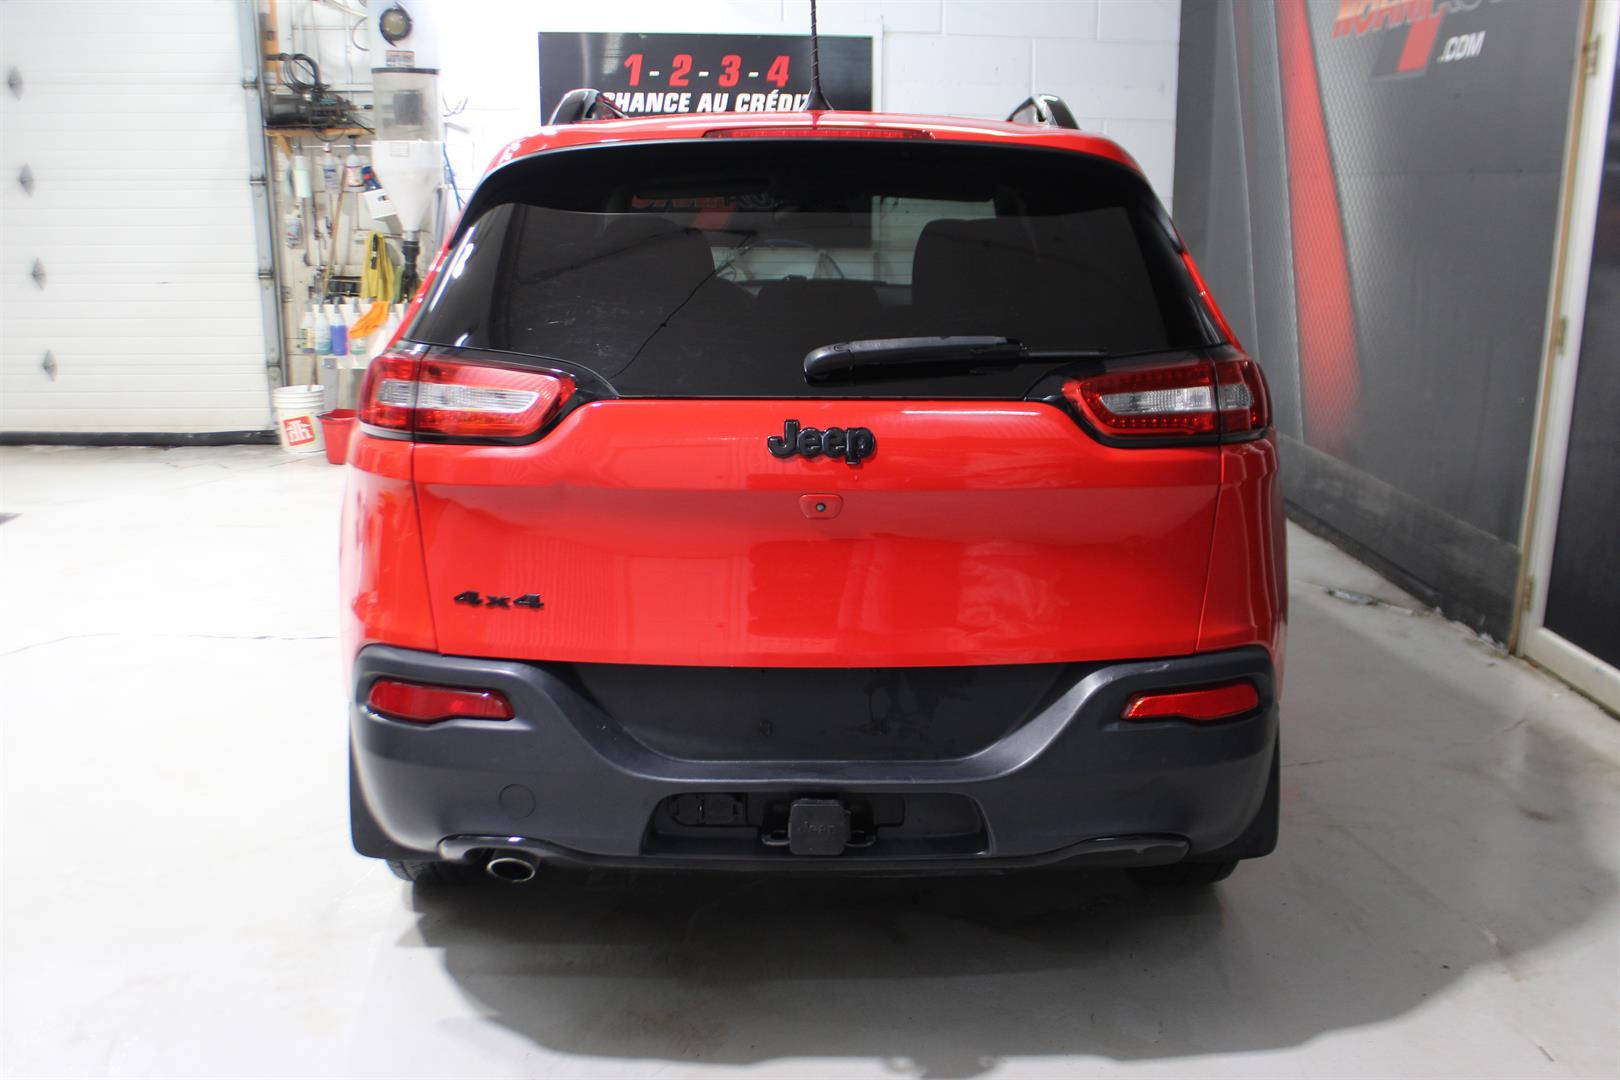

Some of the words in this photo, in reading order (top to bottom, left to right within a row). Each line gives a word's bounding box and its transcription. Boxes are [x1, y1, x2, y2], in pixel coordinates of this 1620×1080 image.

[696, 93, 729, 113] AU
[767, 419, 876, 464] Jeep
[453, 590, 544, 611] 4x4
